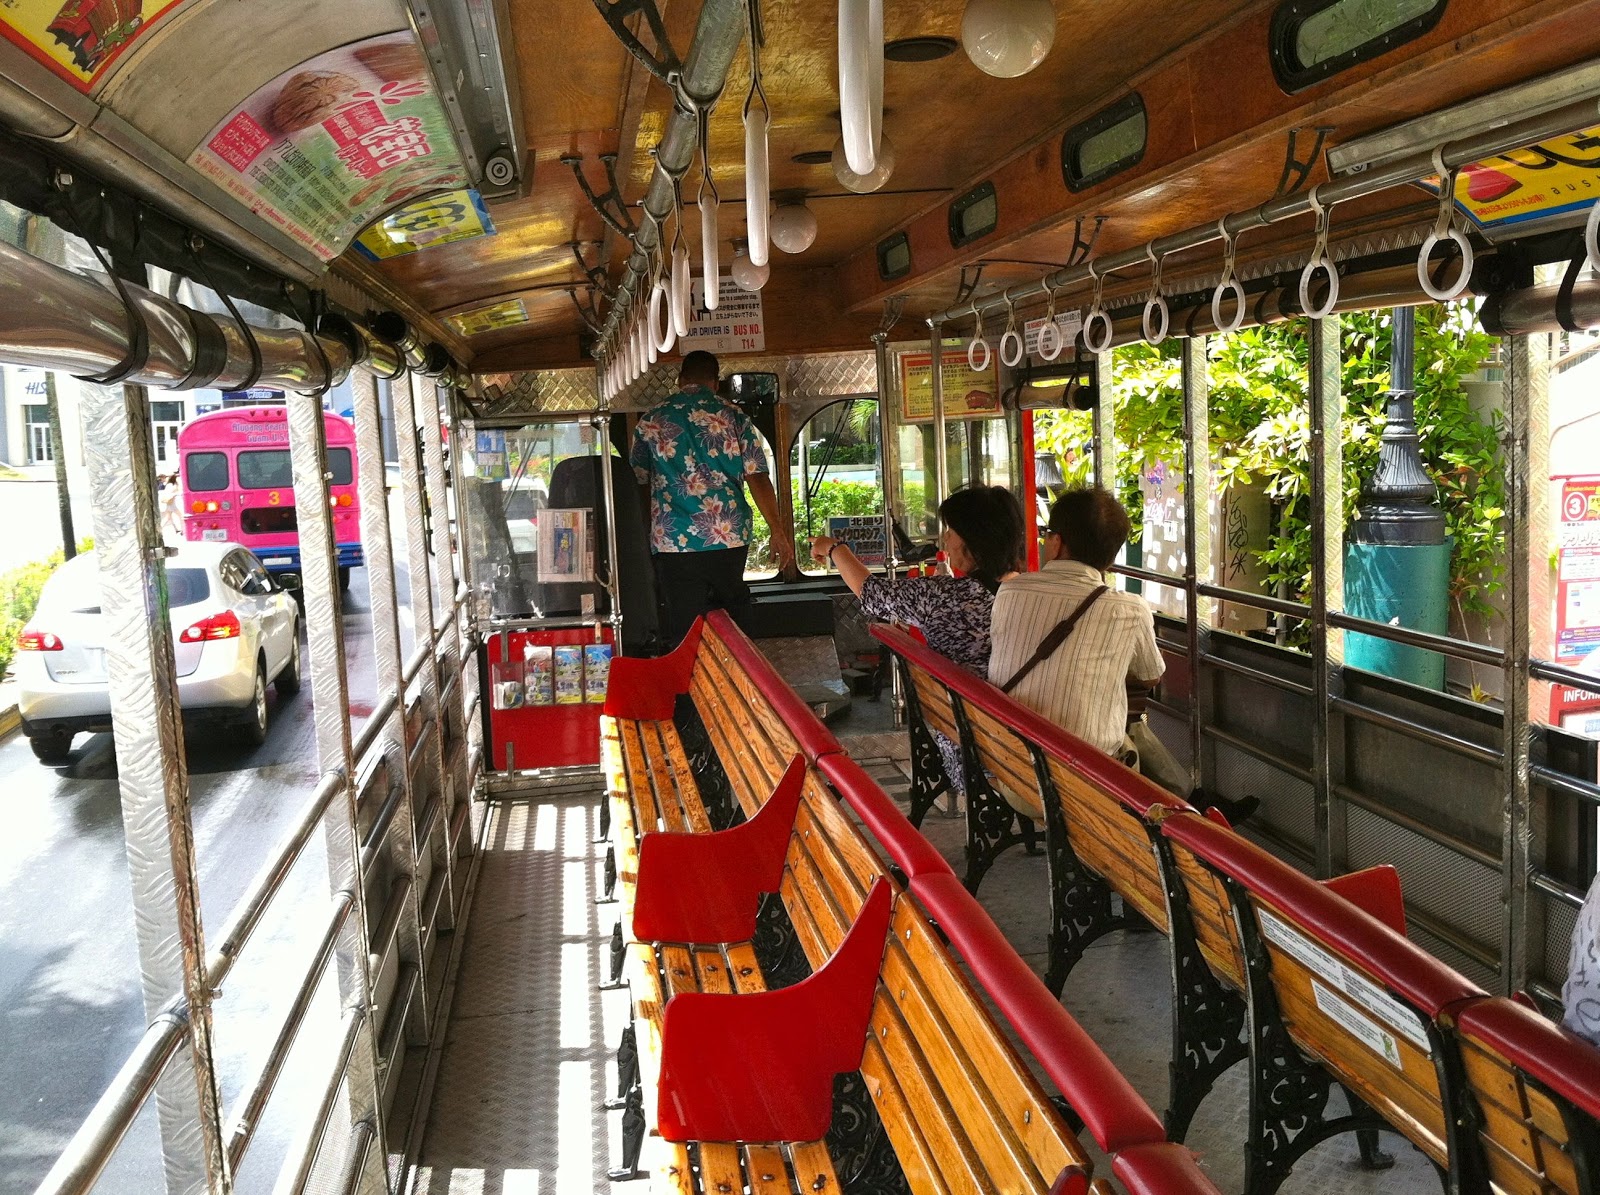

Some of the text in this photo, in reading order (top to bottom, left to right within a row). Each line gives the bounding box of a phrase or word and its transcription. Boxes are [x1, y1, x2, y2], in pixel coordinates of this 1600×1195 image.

[699, 326, 722, 336] DRIVER
[723, 325, 730, 335] IS
[733, 323, 761, 336] BUS NO.
[742, 339, 755, 350] T14
[268, 491, 280, 505] 3
